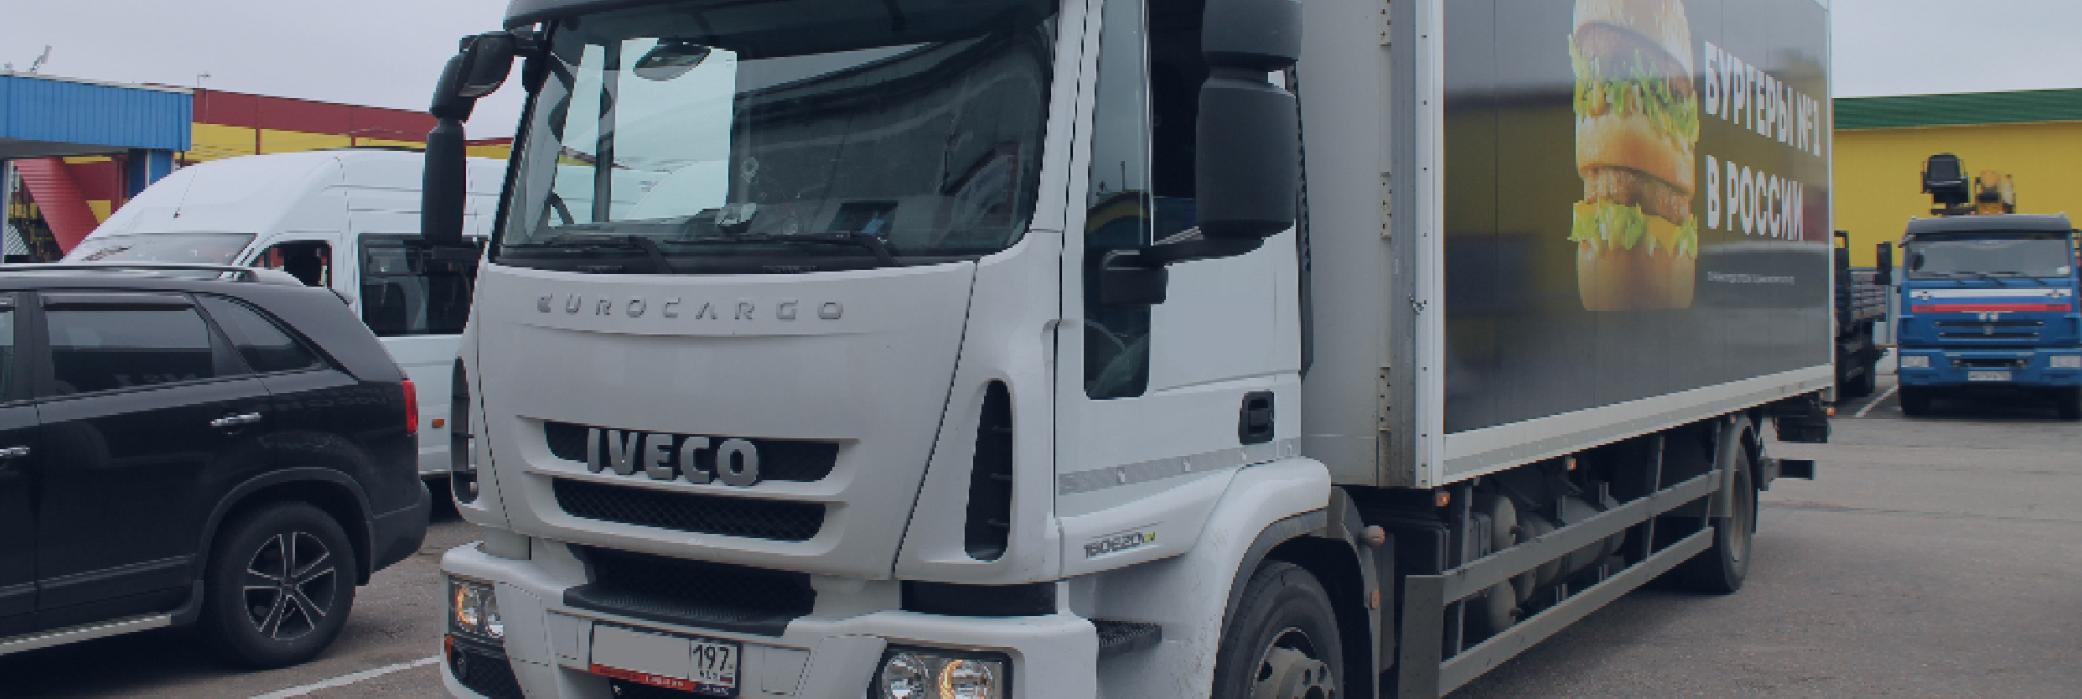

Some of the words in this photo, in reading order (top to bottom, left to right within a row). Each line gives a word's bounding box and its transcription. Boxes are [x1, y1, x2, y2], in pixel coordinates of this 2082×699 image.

[1705, 41, 1794, 147] БУРГЕРЫ
[1706, 154, 1720, 230] В
[1727, 160, 1804, 241] РОССИИ
[536, 292, 844, 321] EUROCARGO
[587, 427, 759, 486] IVECO
[692, 644, 729, 671] 197
